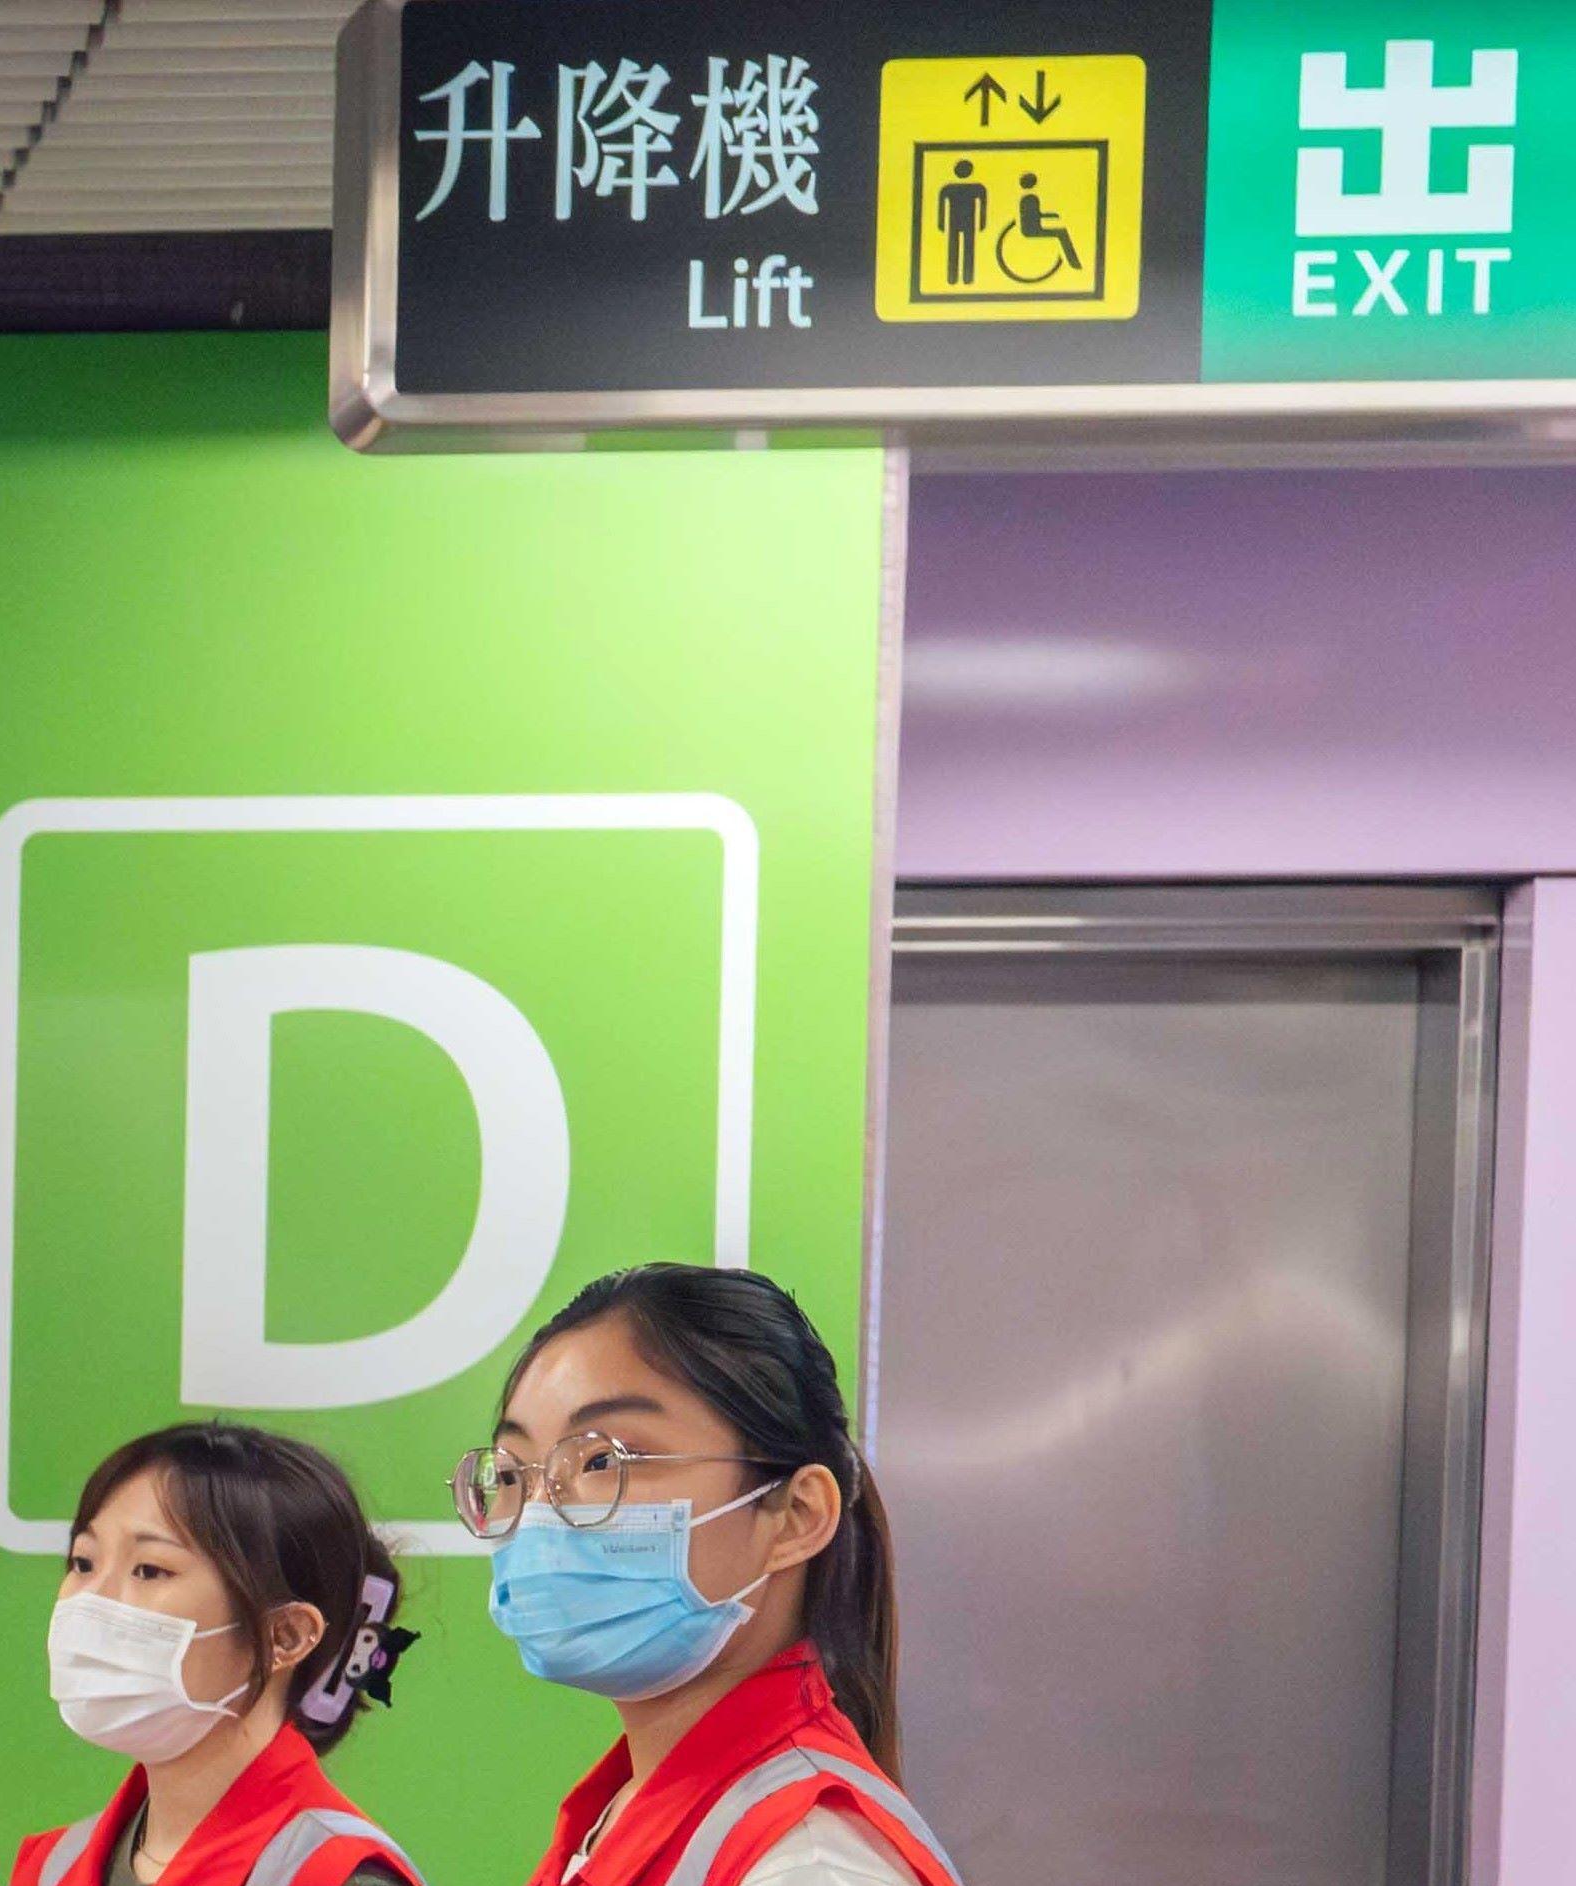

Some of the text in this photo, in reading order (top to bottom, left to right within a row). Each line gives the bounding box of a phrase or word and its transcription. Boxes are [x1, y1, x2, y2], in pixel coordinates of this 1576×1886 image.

[413, 54, 820, 221] 升降機
[1295, 39, 1518, 237] 出
[688, 254, 814, 328] Lift
[1292, 247, 1512, 316] EXIT
[179, 943, 571, 1409] D
